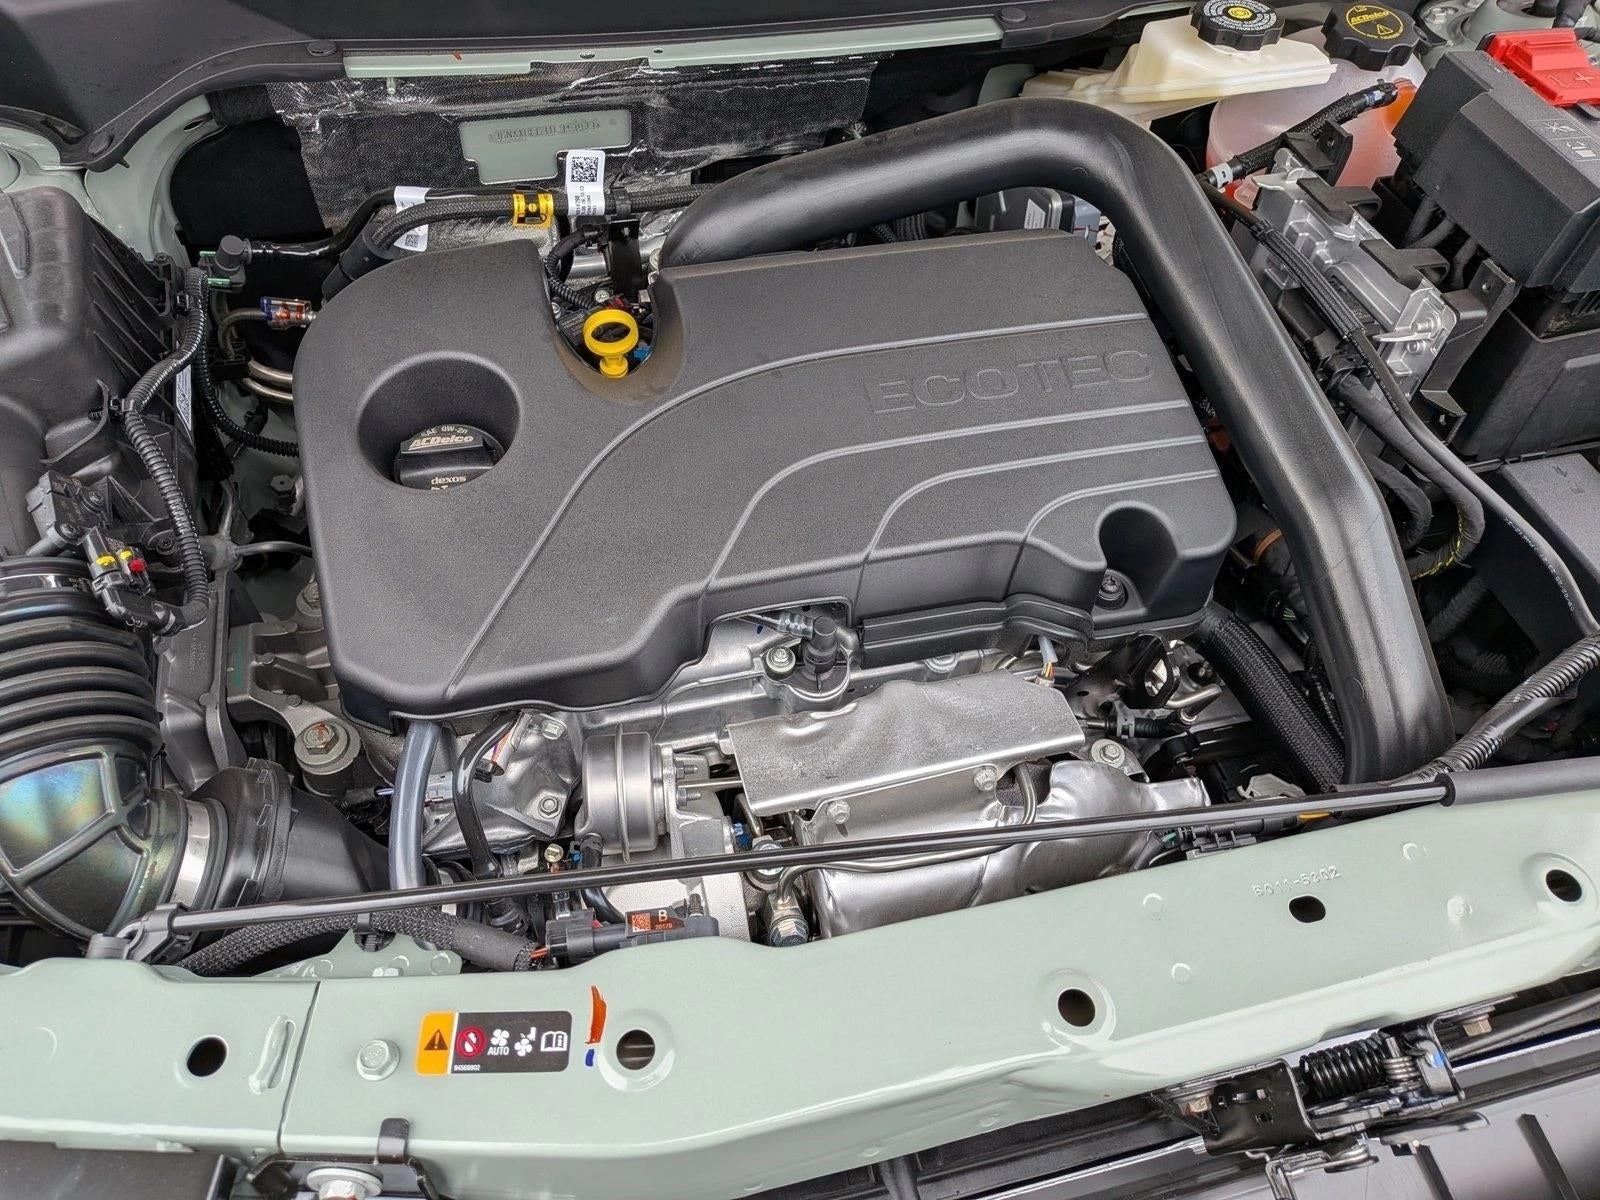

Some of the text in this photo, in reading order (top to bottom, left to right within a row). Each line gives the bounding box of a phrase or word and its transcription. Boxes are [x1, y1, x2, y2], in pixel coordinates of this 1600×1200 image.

[1350, 11, 1390, 24] ACDelco
[863, 350, 1153, 415] ECOTEC
[408, 434, 474, 448] ACDelco
[430, 476, 467, 485] dexos
[658, 909, 668, 922] B
[487, 1046, 510, 1056] AUTO
